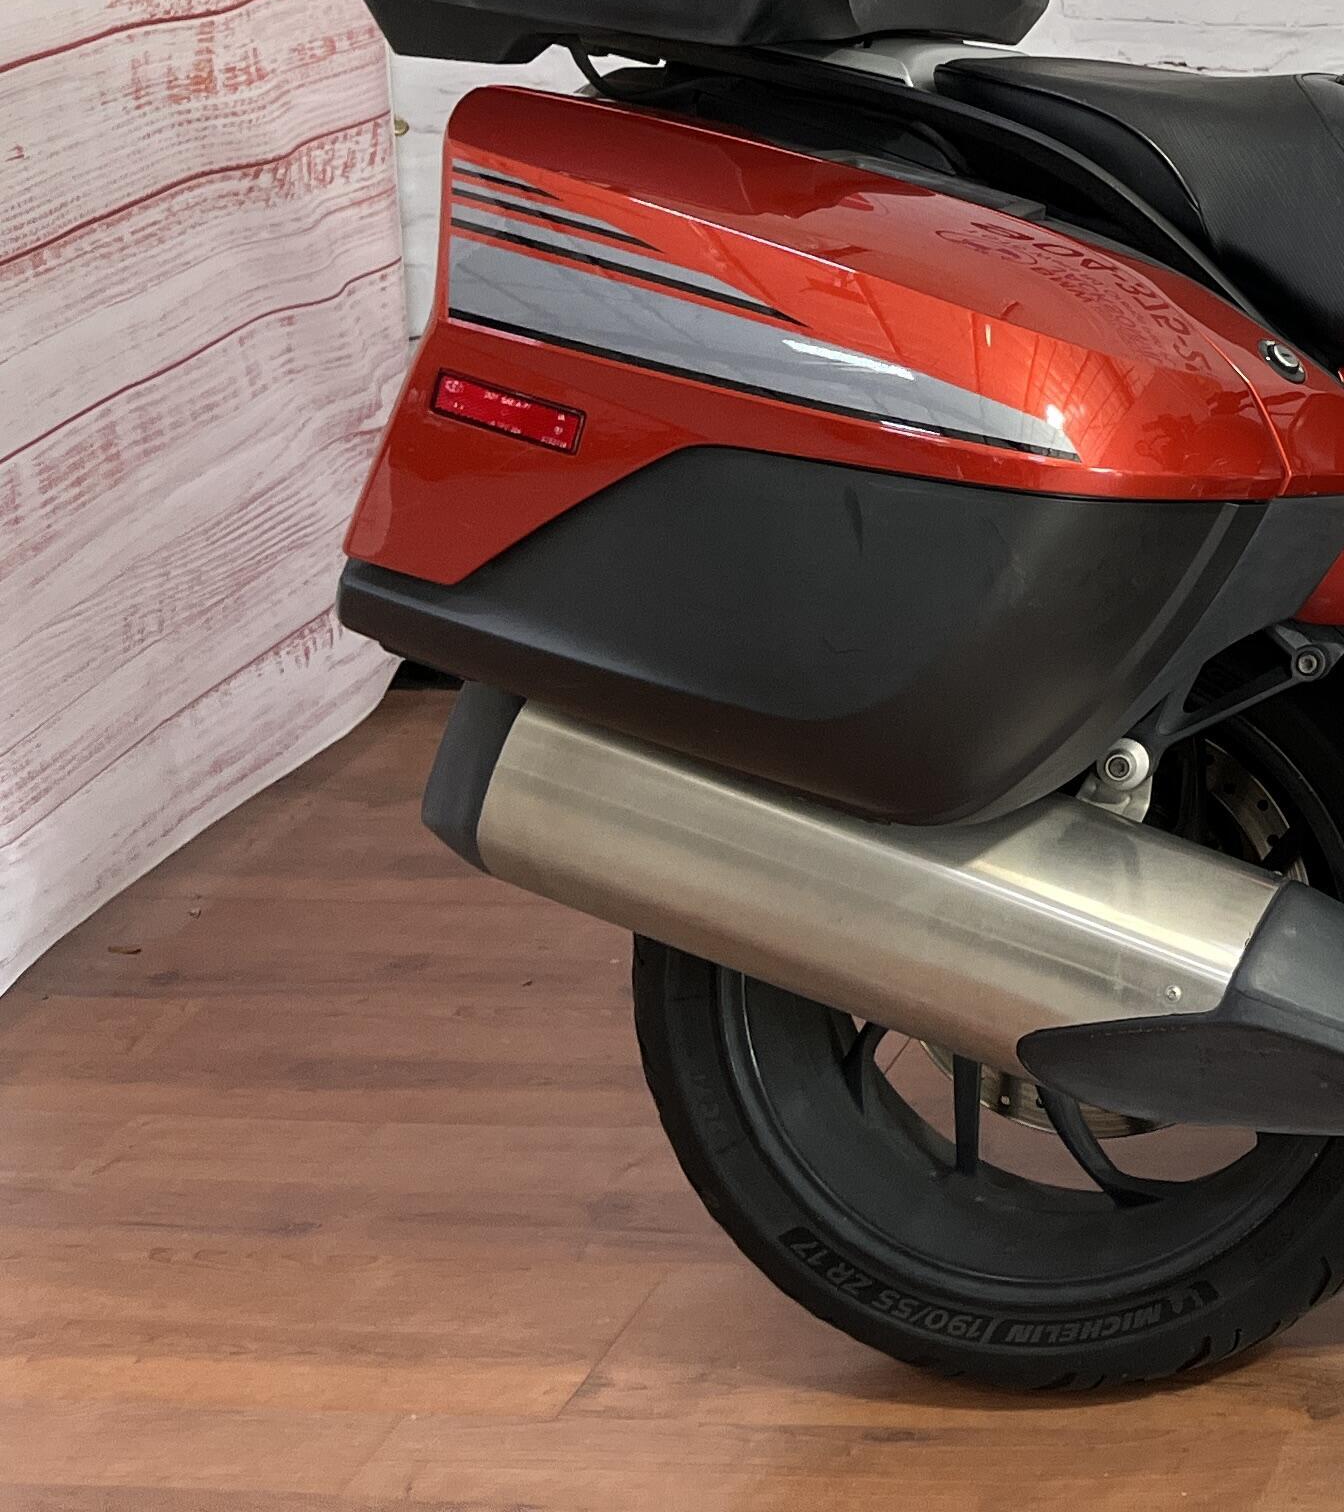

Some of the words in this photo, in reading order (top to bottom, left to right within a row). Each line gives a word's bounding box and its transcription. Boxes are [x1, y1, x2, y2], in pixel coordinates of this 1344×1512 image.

[790, 1240, 827, 1267] 17
[823, 1262, 873, 1297] ZR
[872, 1289, 984, 1344] 190/55
[1005, 1304, 1163, 1345] MICHELIN
